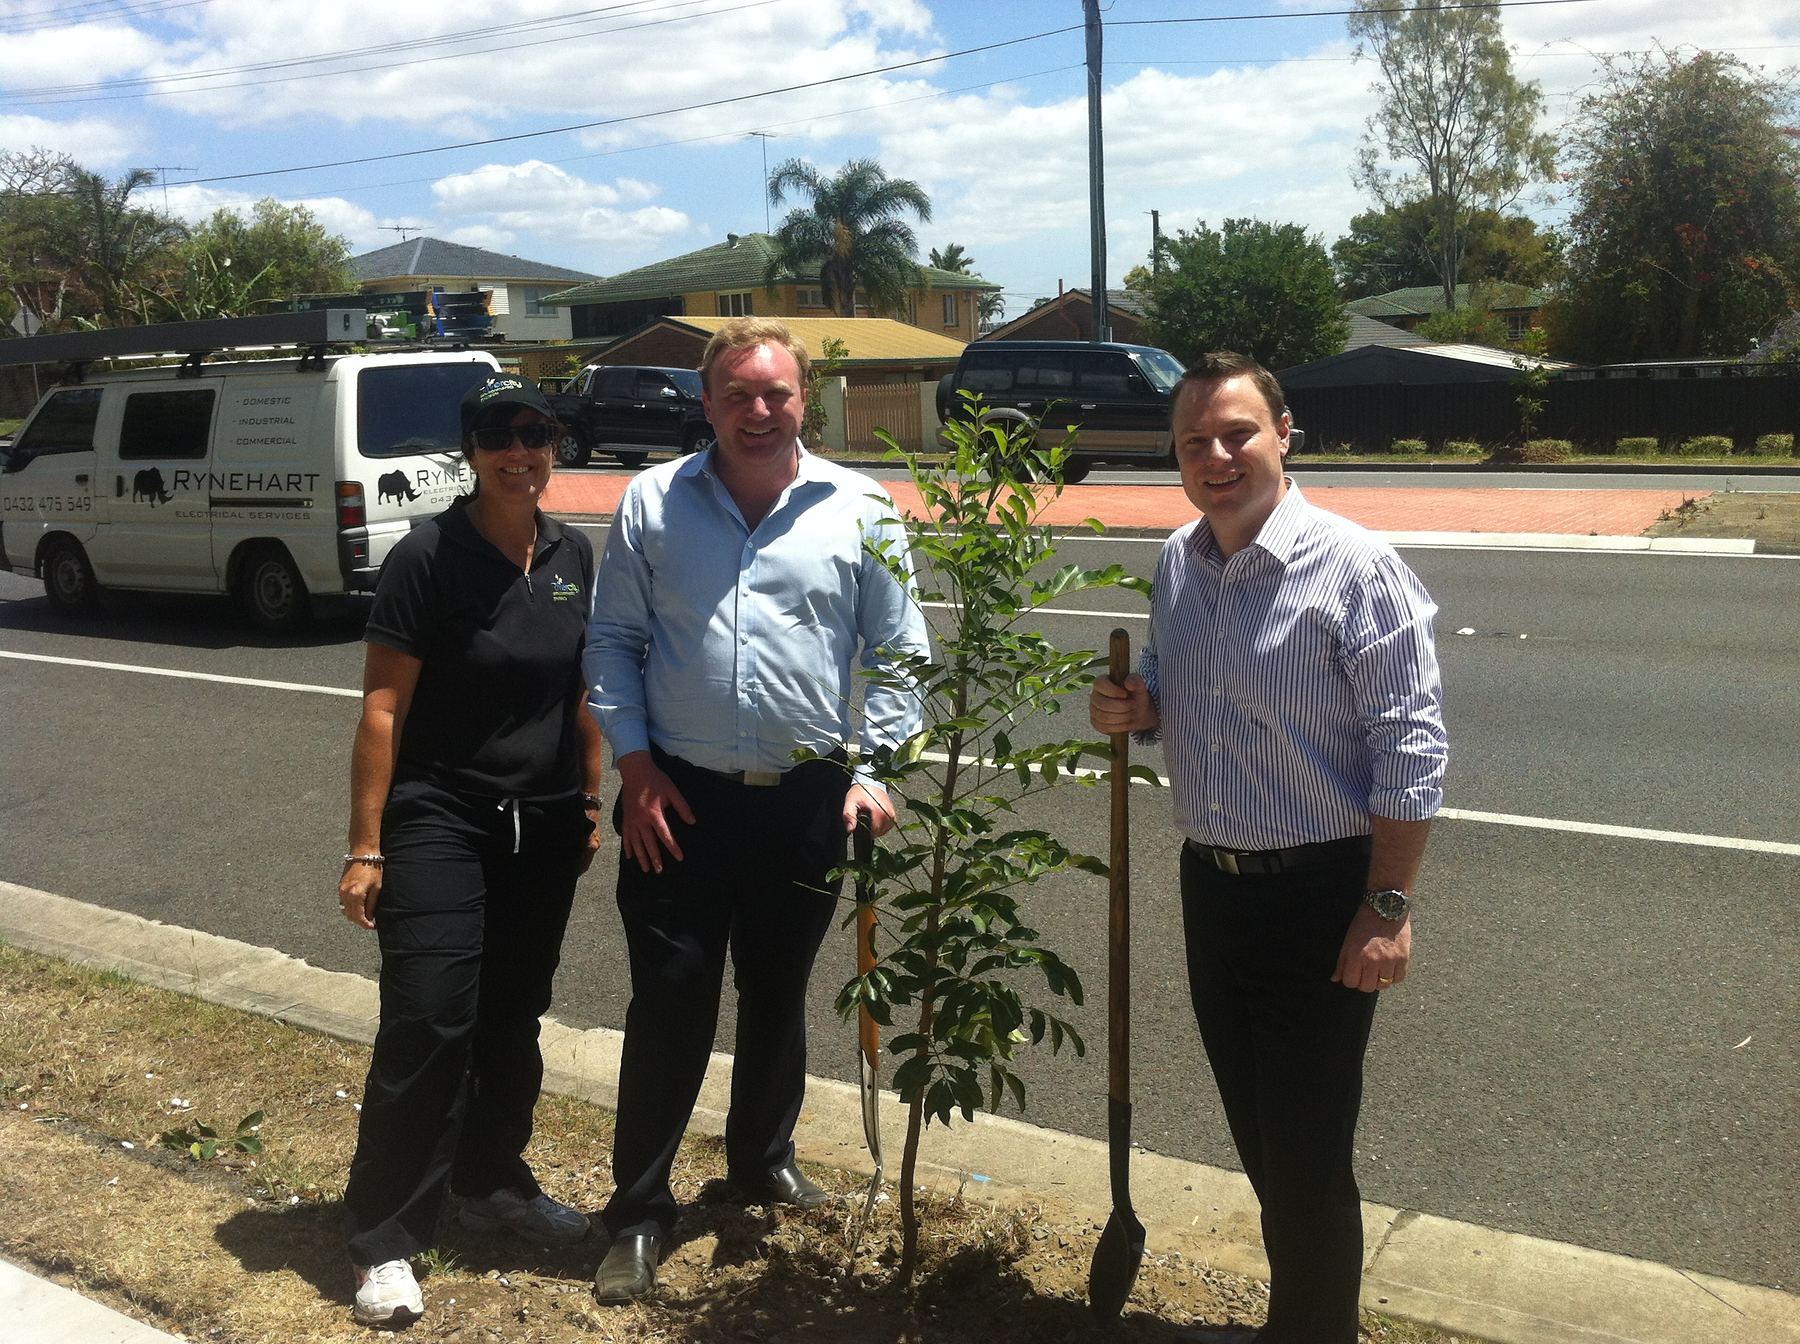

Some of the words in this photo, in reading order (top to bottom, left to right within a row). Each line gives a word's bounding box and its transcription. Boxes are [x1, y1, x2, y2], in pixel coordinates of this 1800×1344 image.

[242, 397, 292, 406] DOMESTIC
[239, 416, 296, 425] INDUSTRIAL
[236, 437, 298, 446] COMMERCIAL
[173, 470, 321, 492] RYNEHART
[3, 496, 34, 512] 0432
[38, 496, 63, 512] 475
[67, 496, 92, 512] 549
[175, 510, 246, 519] ELECTRICAL
[249, 511, 312, 521] SERVICES
